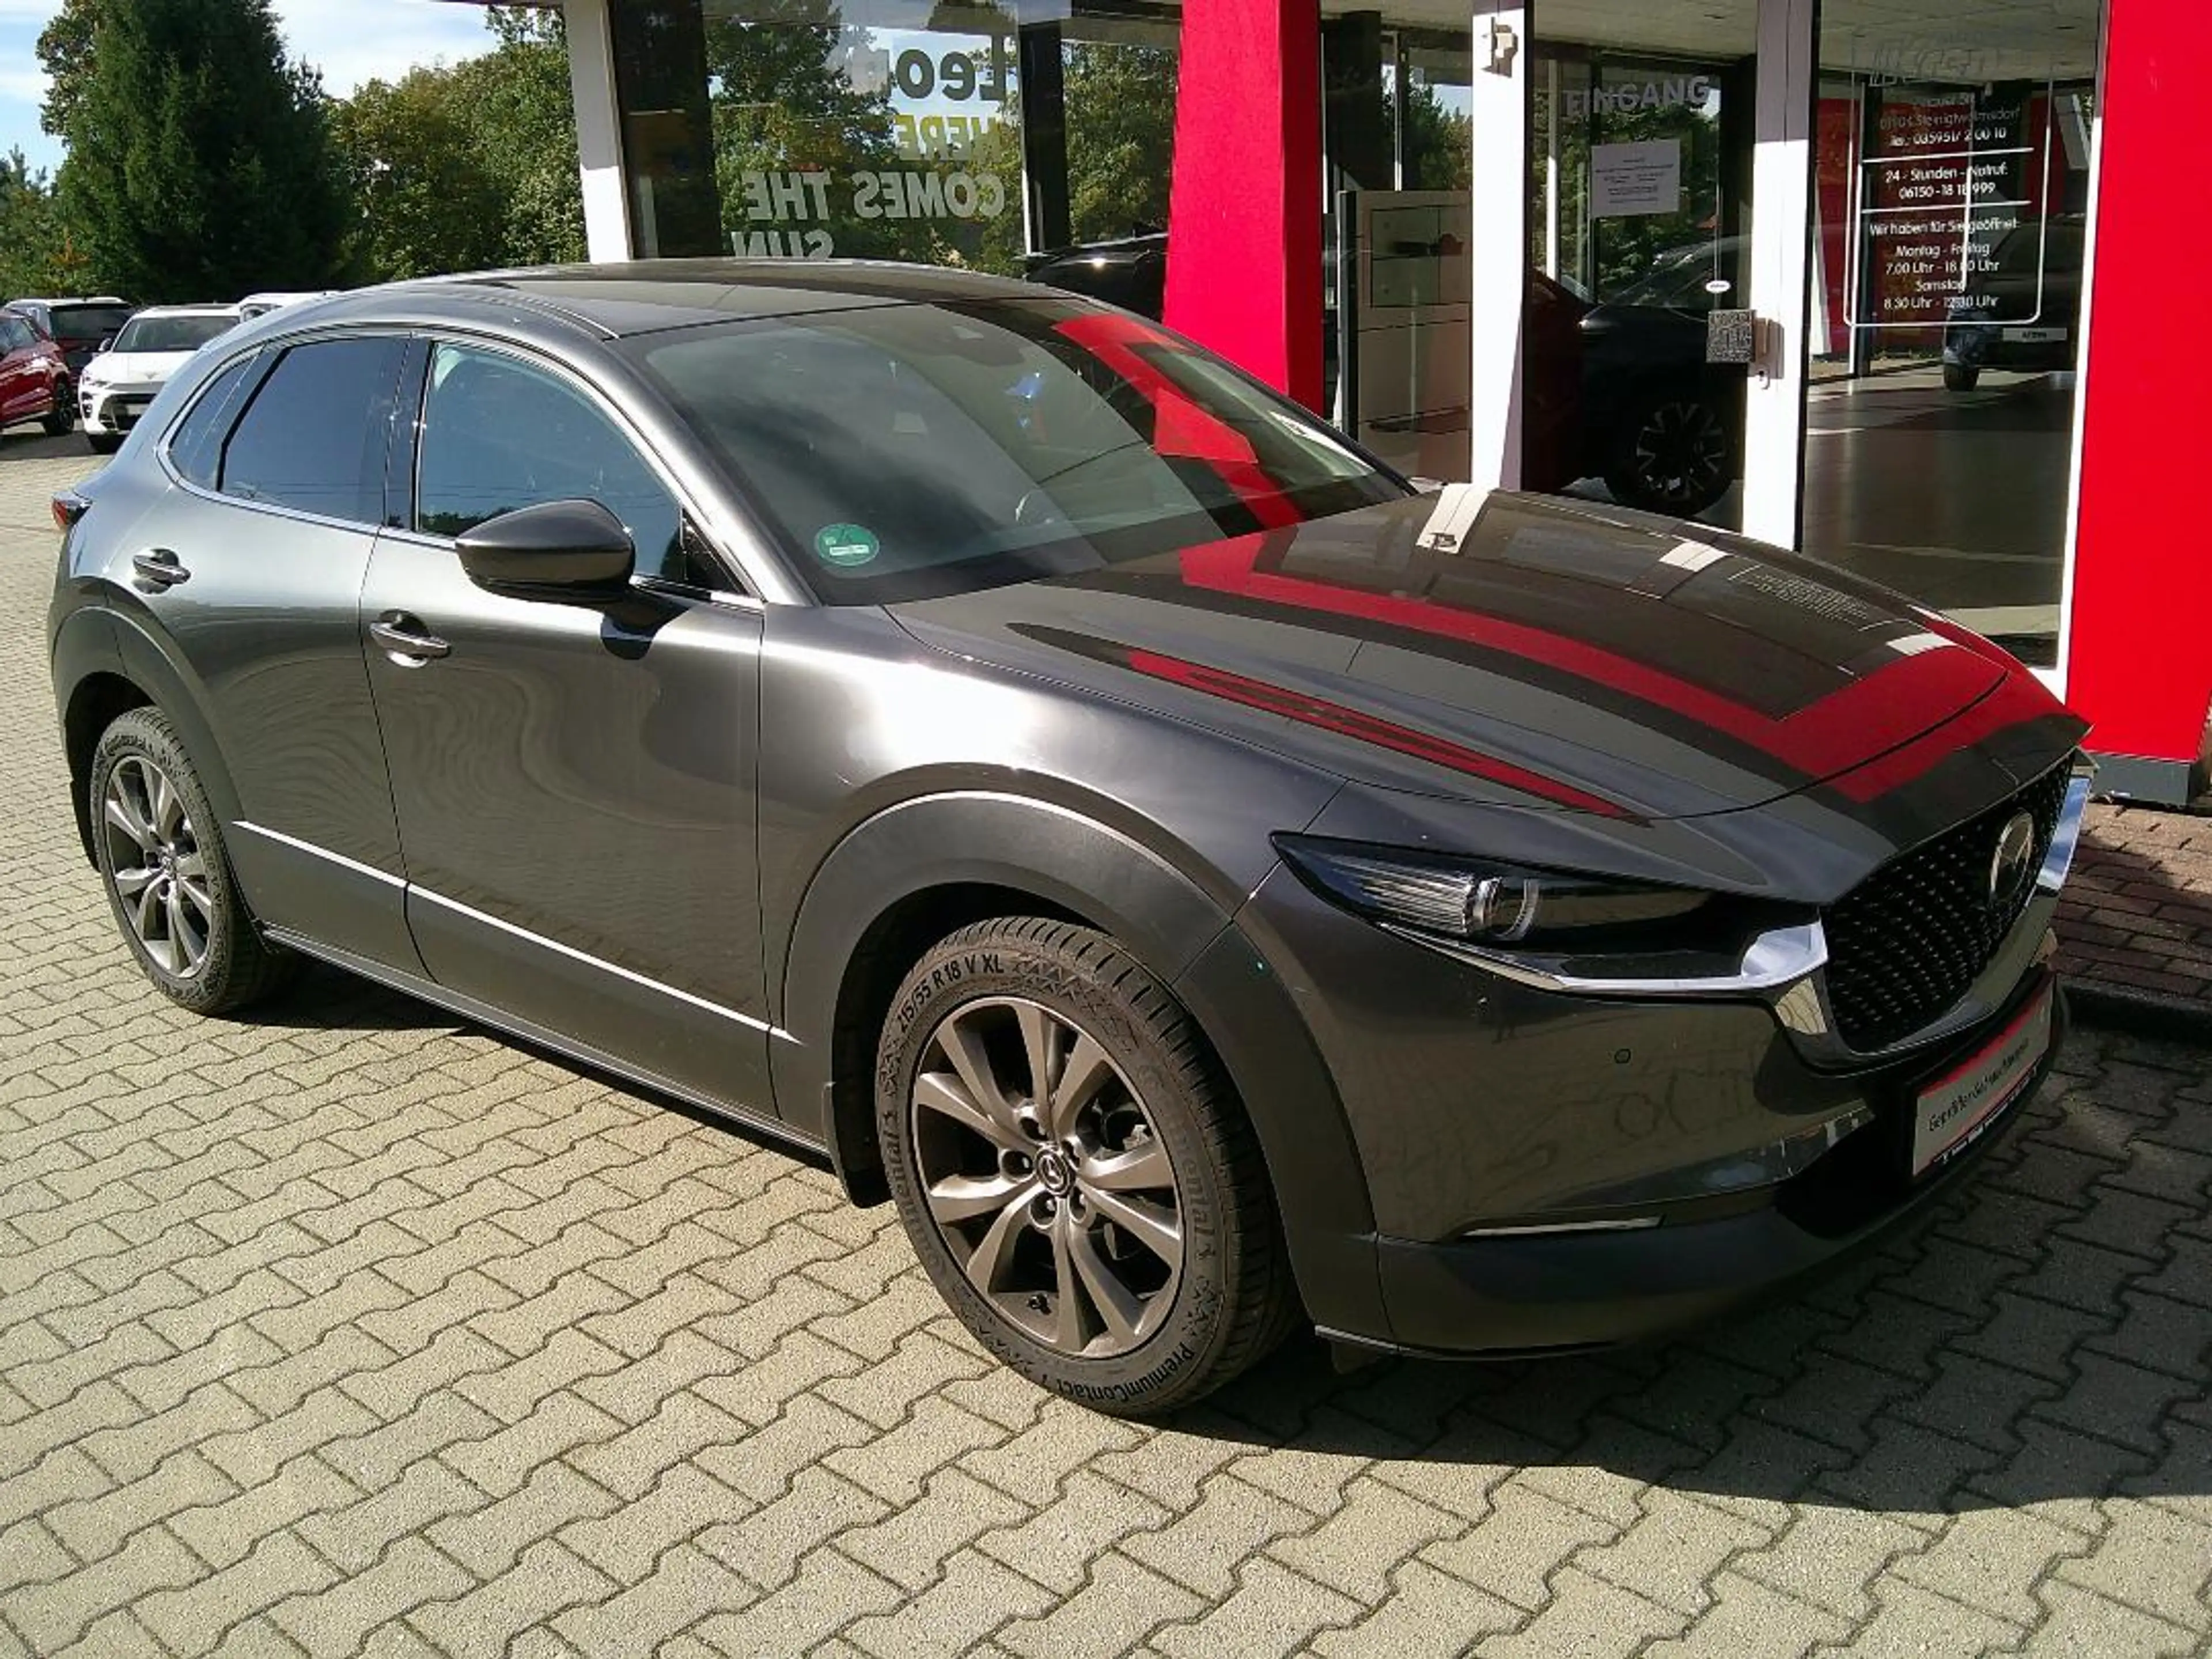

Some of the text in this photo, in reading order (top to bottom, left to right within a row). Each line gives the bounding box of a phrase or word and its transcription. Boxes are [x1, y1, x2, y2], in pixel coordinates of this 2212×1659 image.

[1563, 75, 1710, 118] EINGANG
[1885, 170, 1900, 183] 24
[1910, 166, 1957, 181] Stunden
[1972, 181, 1996, 195] 999
[1870, 224, 1889, 236] Wir
[1890, 222, 1928, 235] haben
[1930, 221, 1947, 233] für
[1895, 243, 1941, 258] Montag
[1912, 262, 1935, 274] Uhr
[1978, 259, 2000, 271] Uhr
[1915, 279, 1965, 293] Samstag
[1911, 295, 1933, 309] Uhr
[1976, 294, 2000, 307] Uhr
[896, 953, 1005, 1033] 215/55 R 18 V XL
[1055, 1340, 1196, 1402] PremiumContact
